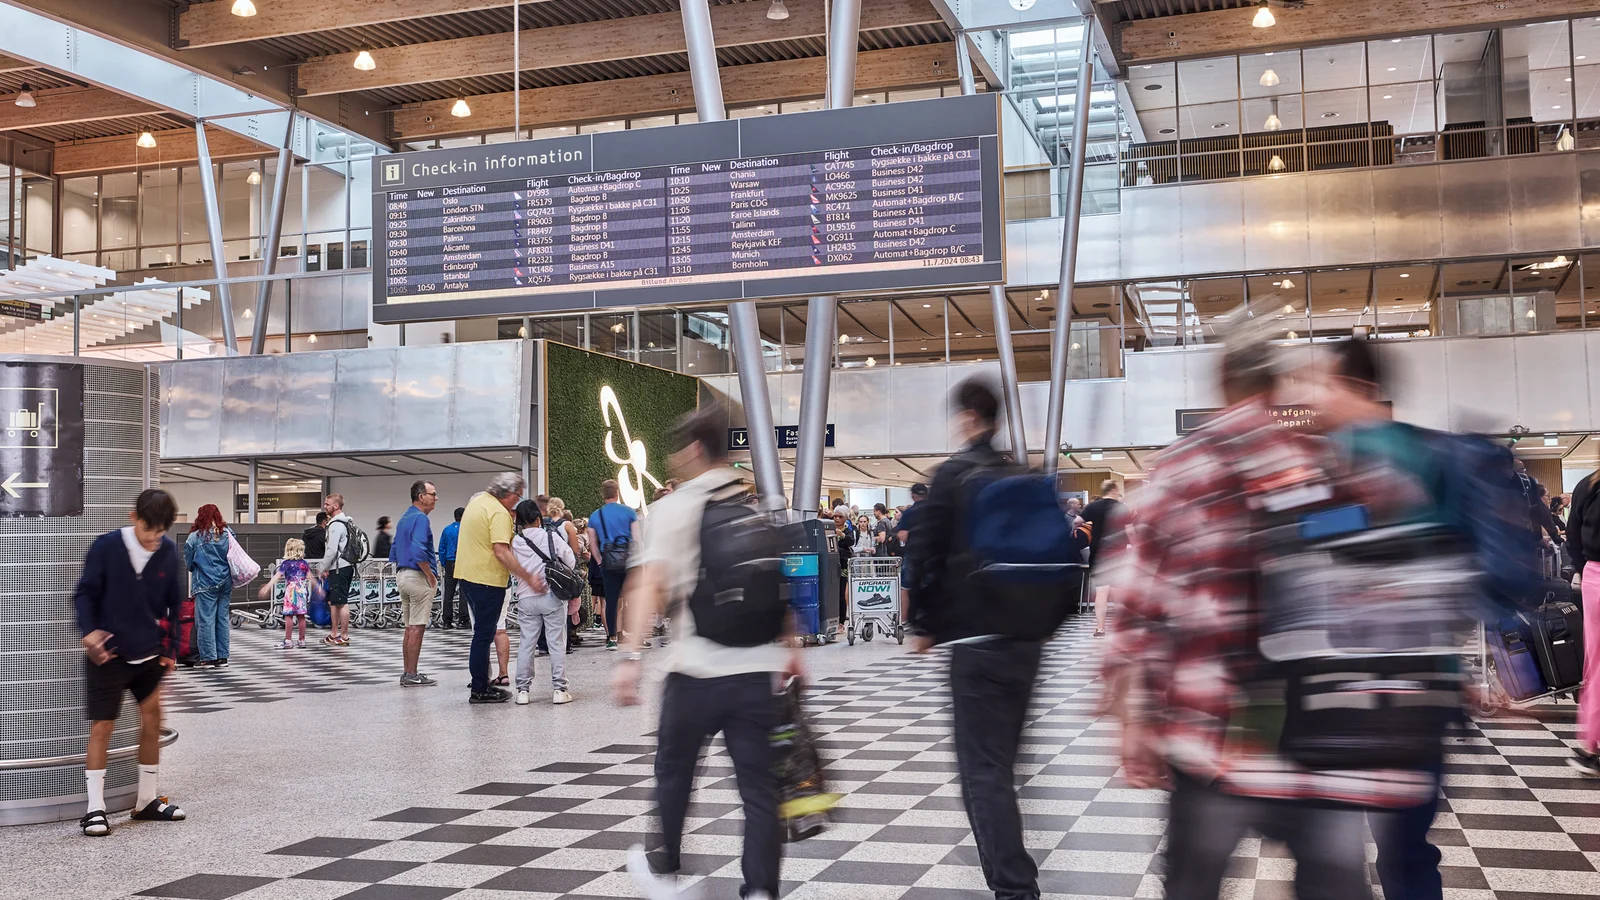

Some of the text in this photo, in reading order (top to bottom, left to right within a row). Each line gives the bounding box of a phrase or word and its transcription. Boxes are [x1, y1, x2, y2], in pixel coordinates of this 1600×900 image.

[412, 149, 583, 177] Check-in information
[670, 142, 954, 175] Time New Destination Flight Check-in/Bagdrop
[730, 171, 756, 180] Chania
[825, 162, 855, 171] CAT745
[872, 157, 911, 169] Rygsække
[918, 154, 941, 163] bakke
[944, 153, 954, 162] på
[390, 171, 641, 200] Time New Destination Flight Check-in/Bagdrop
[568, 182, 634, 196] Automat+Bagdrop
[730, 181, 760, 190] Warsaw
[826, 173, 850, 181] LO466
[872, 168, 905, 177] Business
[731, 190, 765, 199] Frankfurt
[826, 182, 856, 191] AC9562
[872, 178, 905, 187] Business
[527, 199, 552, 207] FR5179
[571, 195, 601, 205] Bagdrop
[826, 192, 857, 201] MK9625
[872, 188, 905, 198] Business
[443, 215, 476, 224] Zakinthos
[527, 208, 555, 217] GQ7421
[569, 204, 603, 215] Rygsække
[632, 200, 642, 209] på
[753, 209, 780, 218] Islands
[826, 203, 851, 212] RC471
[873, 195, 947, 210] Automat+Bagdrop
[443, 225, 476, 233] Barcelona
[571, 214, 601, 224] Bagdrop
[571, 224, 601, 234] Bagdrop
[731, 221, 756, 229] Tallinn
[826, 214, 850, 222] BT814
[873, 209, 906, 218] Business
[732, 230, 775, 239] Amsterdam
[827, 223, 856, 232] DL9516
[873, 219, 906, 228] Business
[571, 234, 601, 244] Bagdrop
[732, 241, 766, 251] Reykjavik
[827, 234, 854, 242] OG911
[873, 226, 948, 240] Automat+Bagdrop
[443, 253, 481, 262] Amsterdam
[569, 244, 599, 252] Business
[732, 251, 760, 259] Munich
[827, 244, 857, 252] LH2435
[873, 240, 906, 249] Business
[732, 261, 769, 269] Bornholm
[827, 254, 853, 262] DX062
[874, 247, 949, 261] Automat+Bagdrop
[443, 263, 478, 273] Edinburgh
[572, 253, 602, 263] Bagdrop
[570, 263, 599, 271] Business
[923, 258, 958, 266] 11.7.2024
[443, 282, 469, 292] Antalya
[528, 276, 551, 285] XQ575
[570, 272, 604, 283] Rygsække
[634, 269, 644, 278] på
